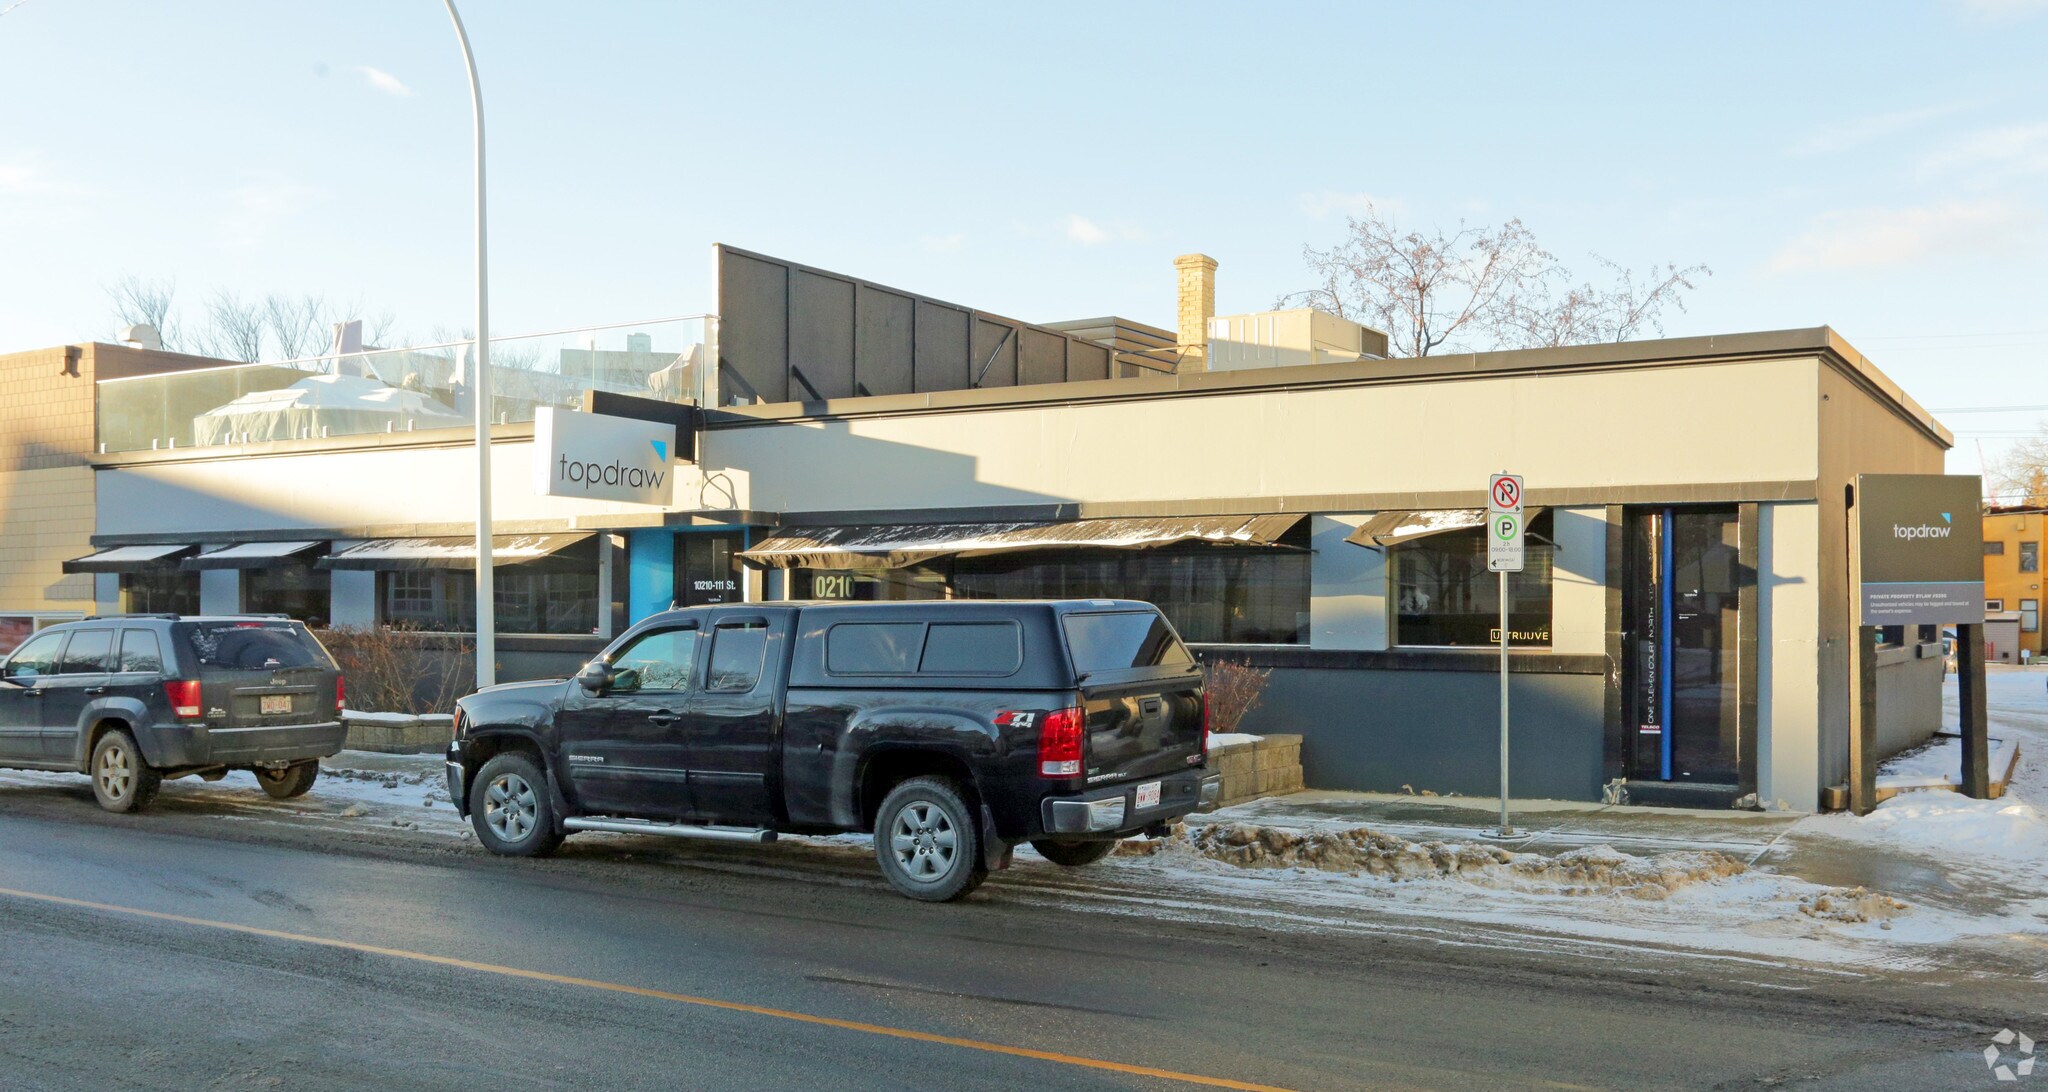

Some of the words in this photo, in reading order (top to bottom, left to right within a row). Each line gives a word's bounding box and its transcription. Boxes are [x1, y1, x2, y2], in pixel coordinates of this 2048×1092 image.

[560, 453, 665, 489] topdraw
[1893, 524, 1951, 541] topdraw
[694, 580, 724, 590] 10210-111
[726, 580, 736, 590] St.
[569, 755, 604, 763] SIERRA
[1087, 772, 1117, 783] SIERRA
